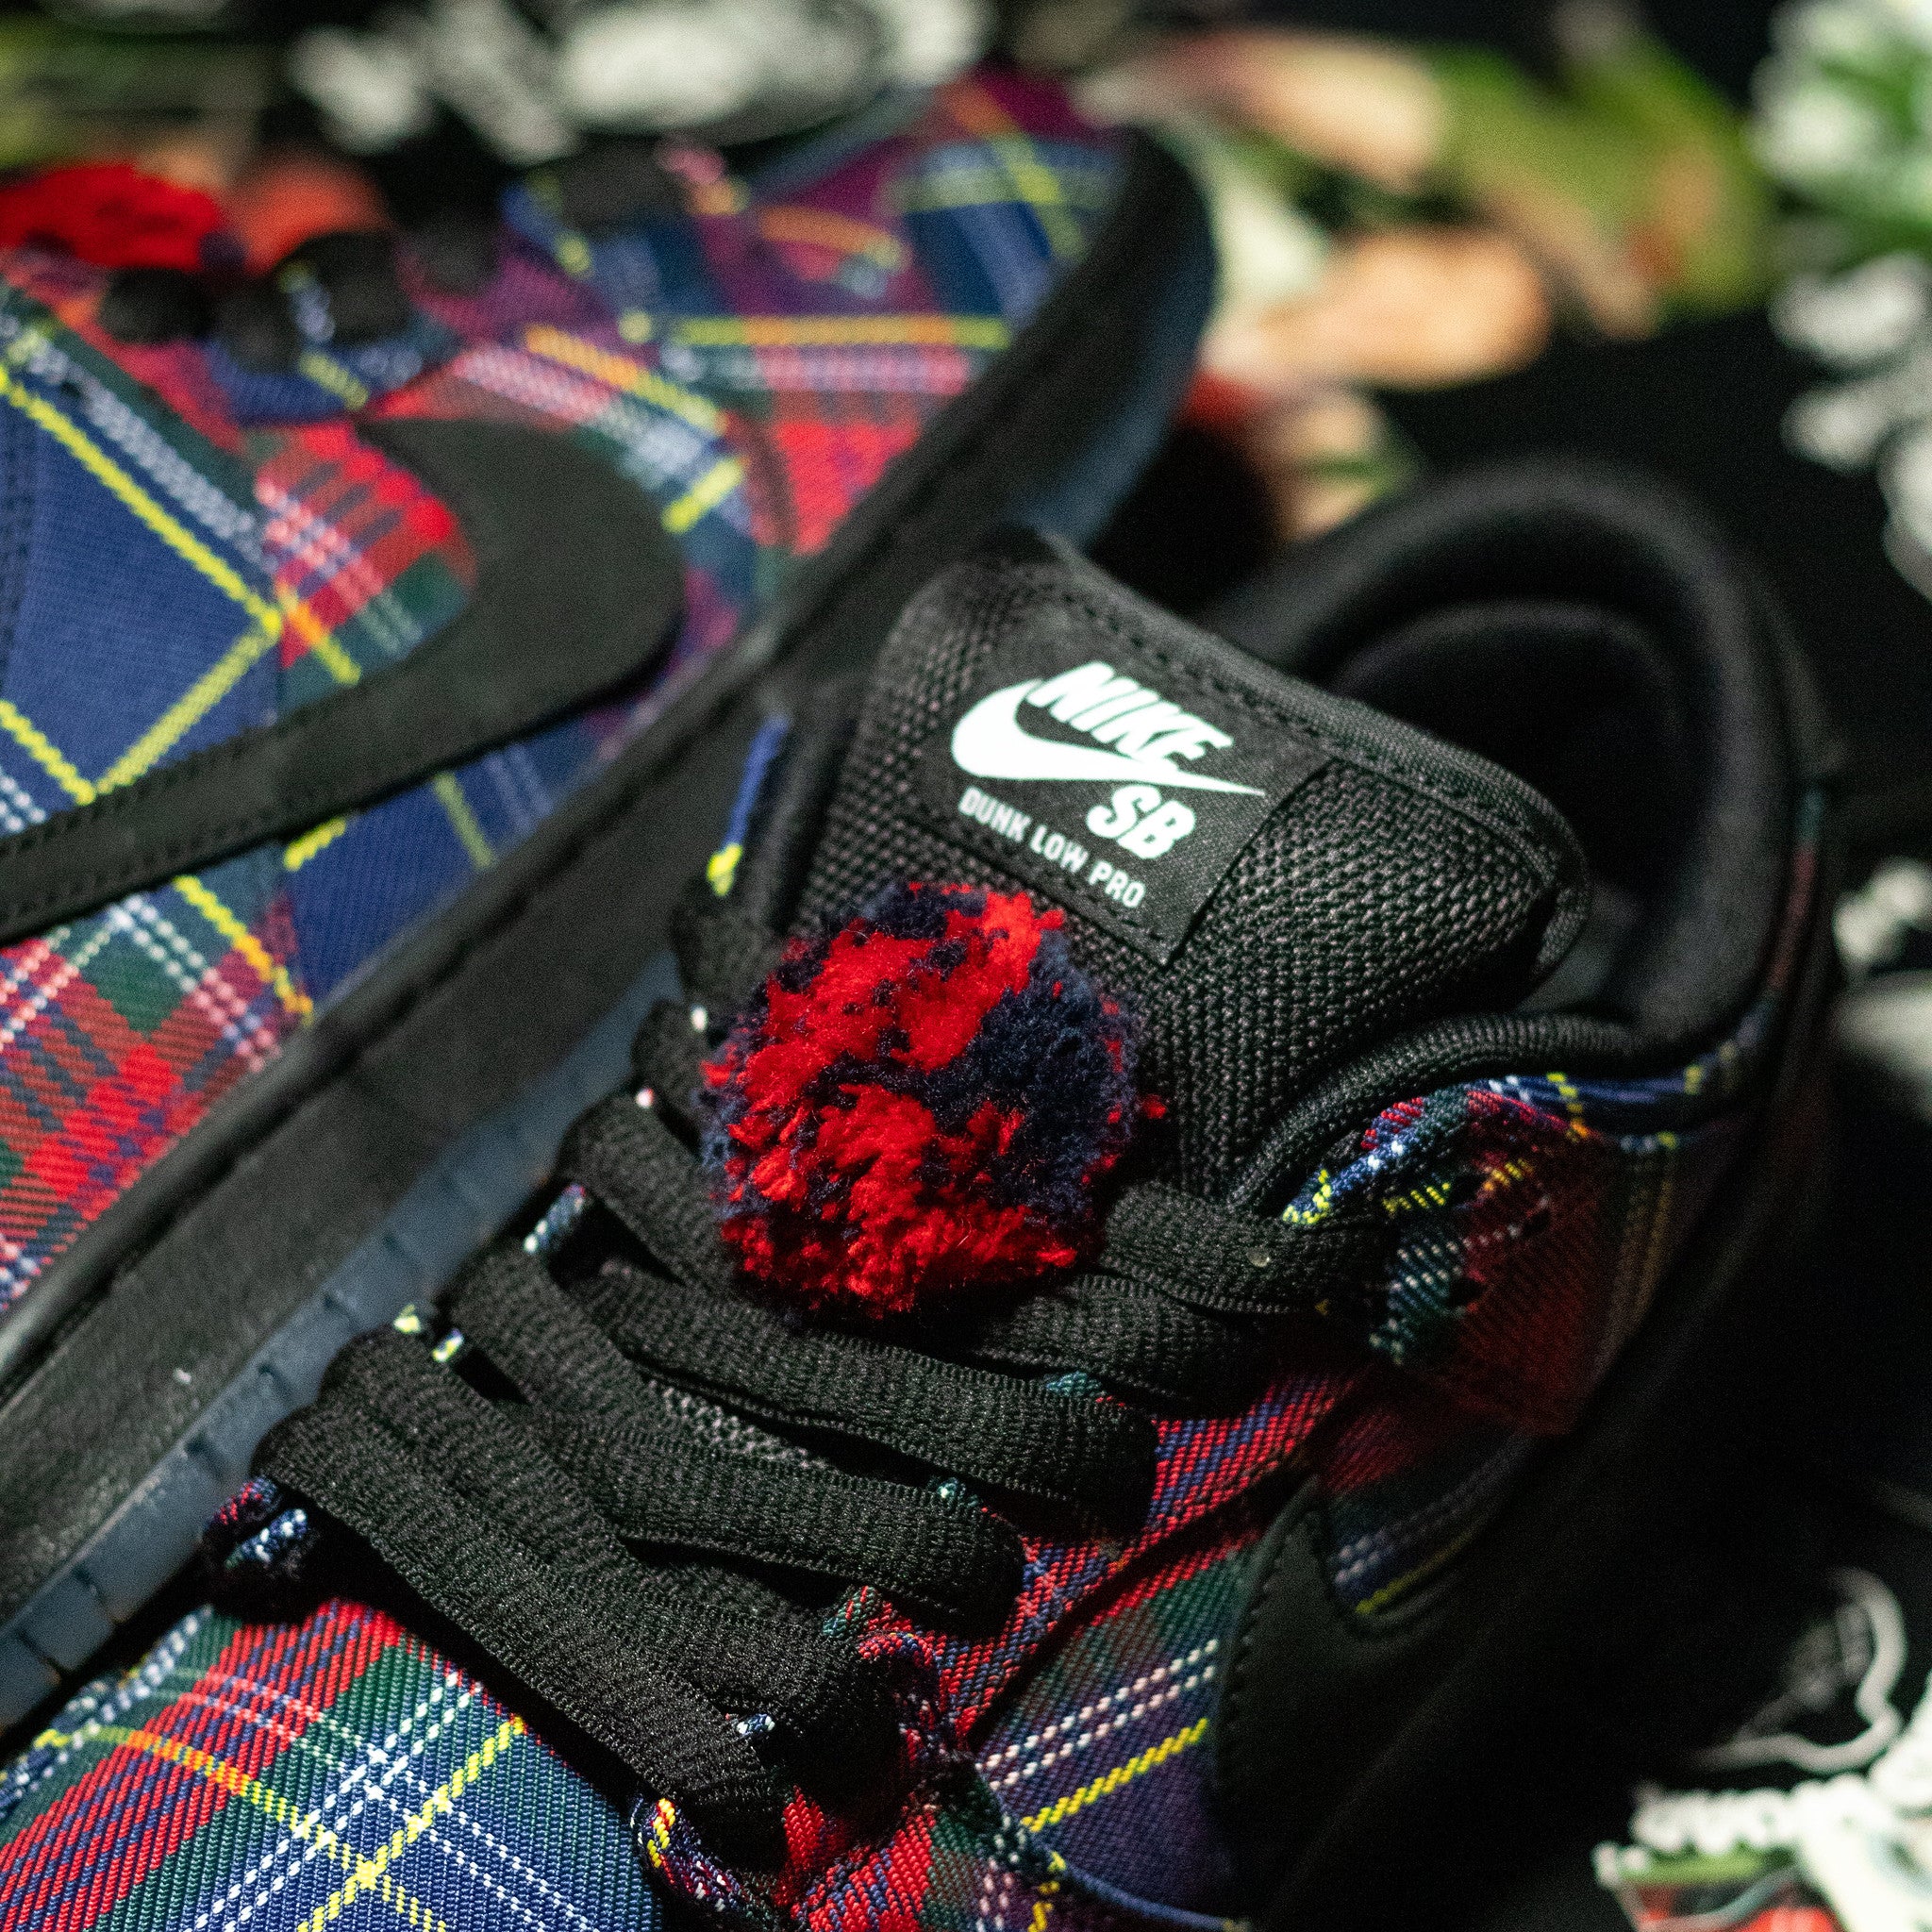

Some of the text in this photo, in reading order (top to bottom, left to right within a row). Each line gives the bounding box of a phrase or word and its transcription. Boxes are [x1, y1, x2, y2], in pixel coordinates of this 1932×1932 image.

[1026, 661, 1234, 771] NIKE
[958, 786, 1146, 908] DUNK LOW PRO
[1086, 784, 1196, 859] SB
